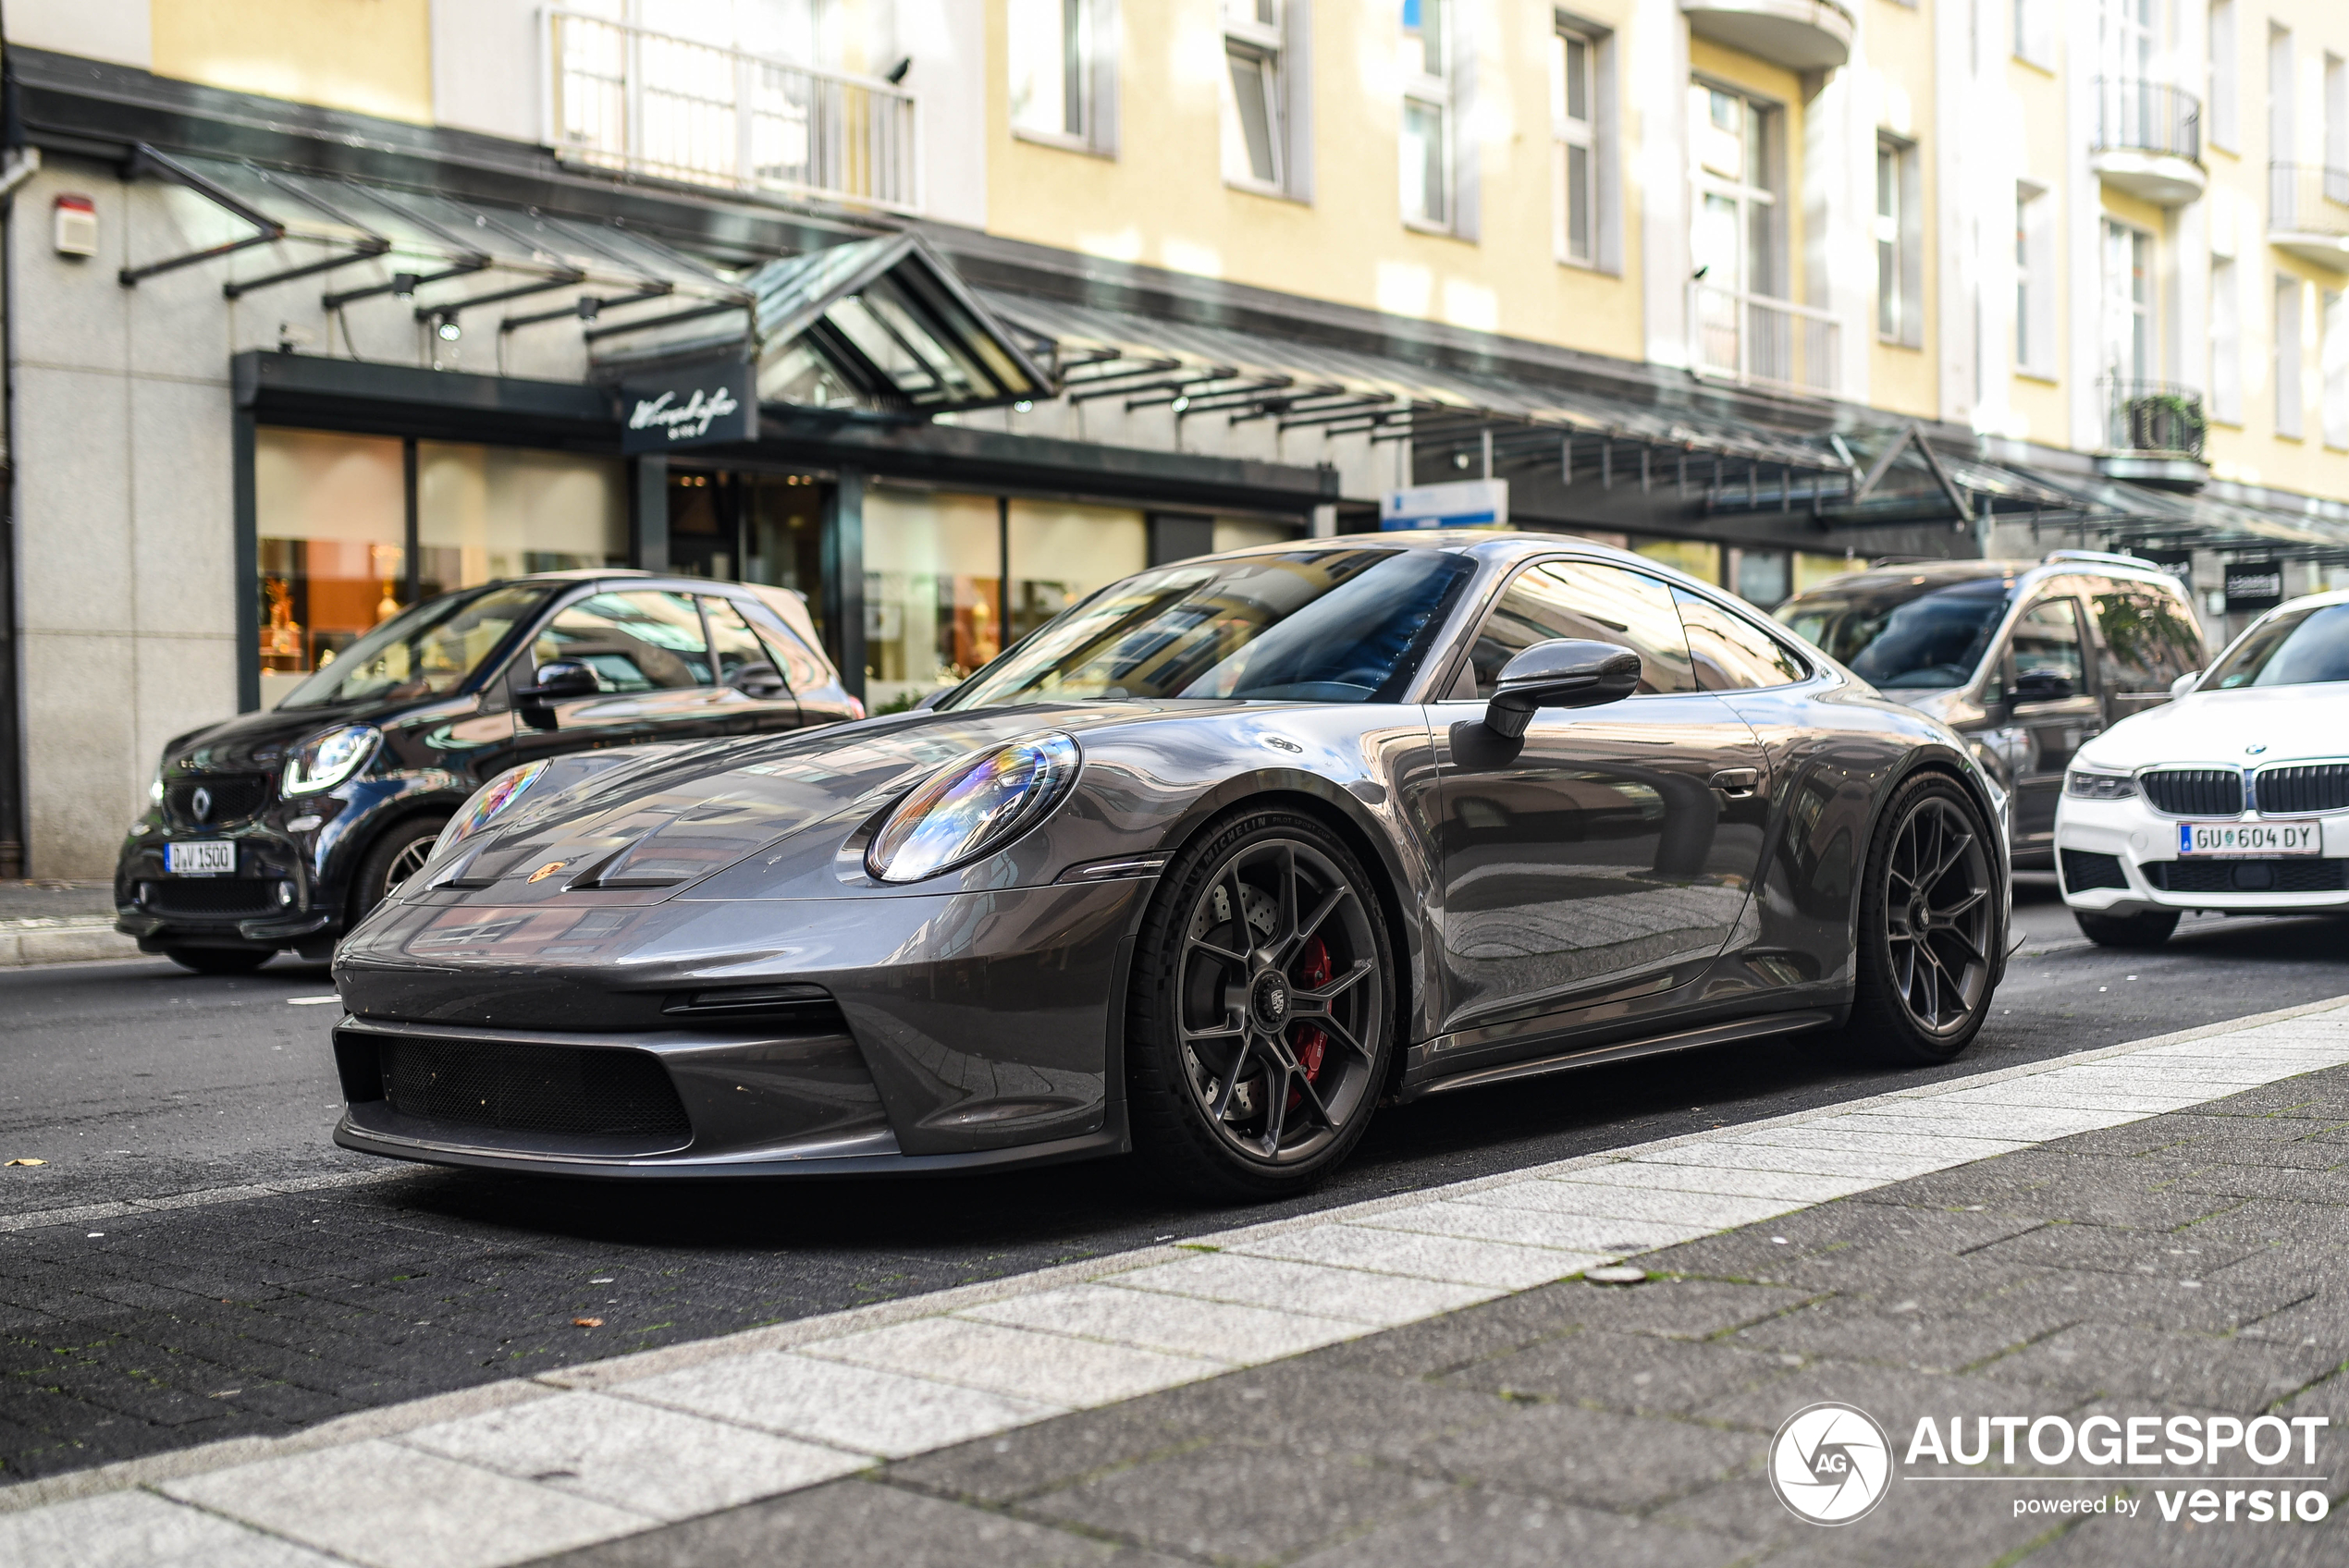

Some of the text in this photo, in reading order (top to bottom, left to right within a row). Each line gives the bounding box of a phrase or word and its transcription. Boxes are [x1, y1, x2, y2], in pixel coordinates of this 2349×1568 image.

[1203, 816, 1266, 865] MICHELIN
[1294, 818, 1316, 831] SPORT
[1317, 829, 1331, 839] CUP
[2196, 827, 2310, 849] GU 604 DY
[199, 845, 228, 868] 1500
